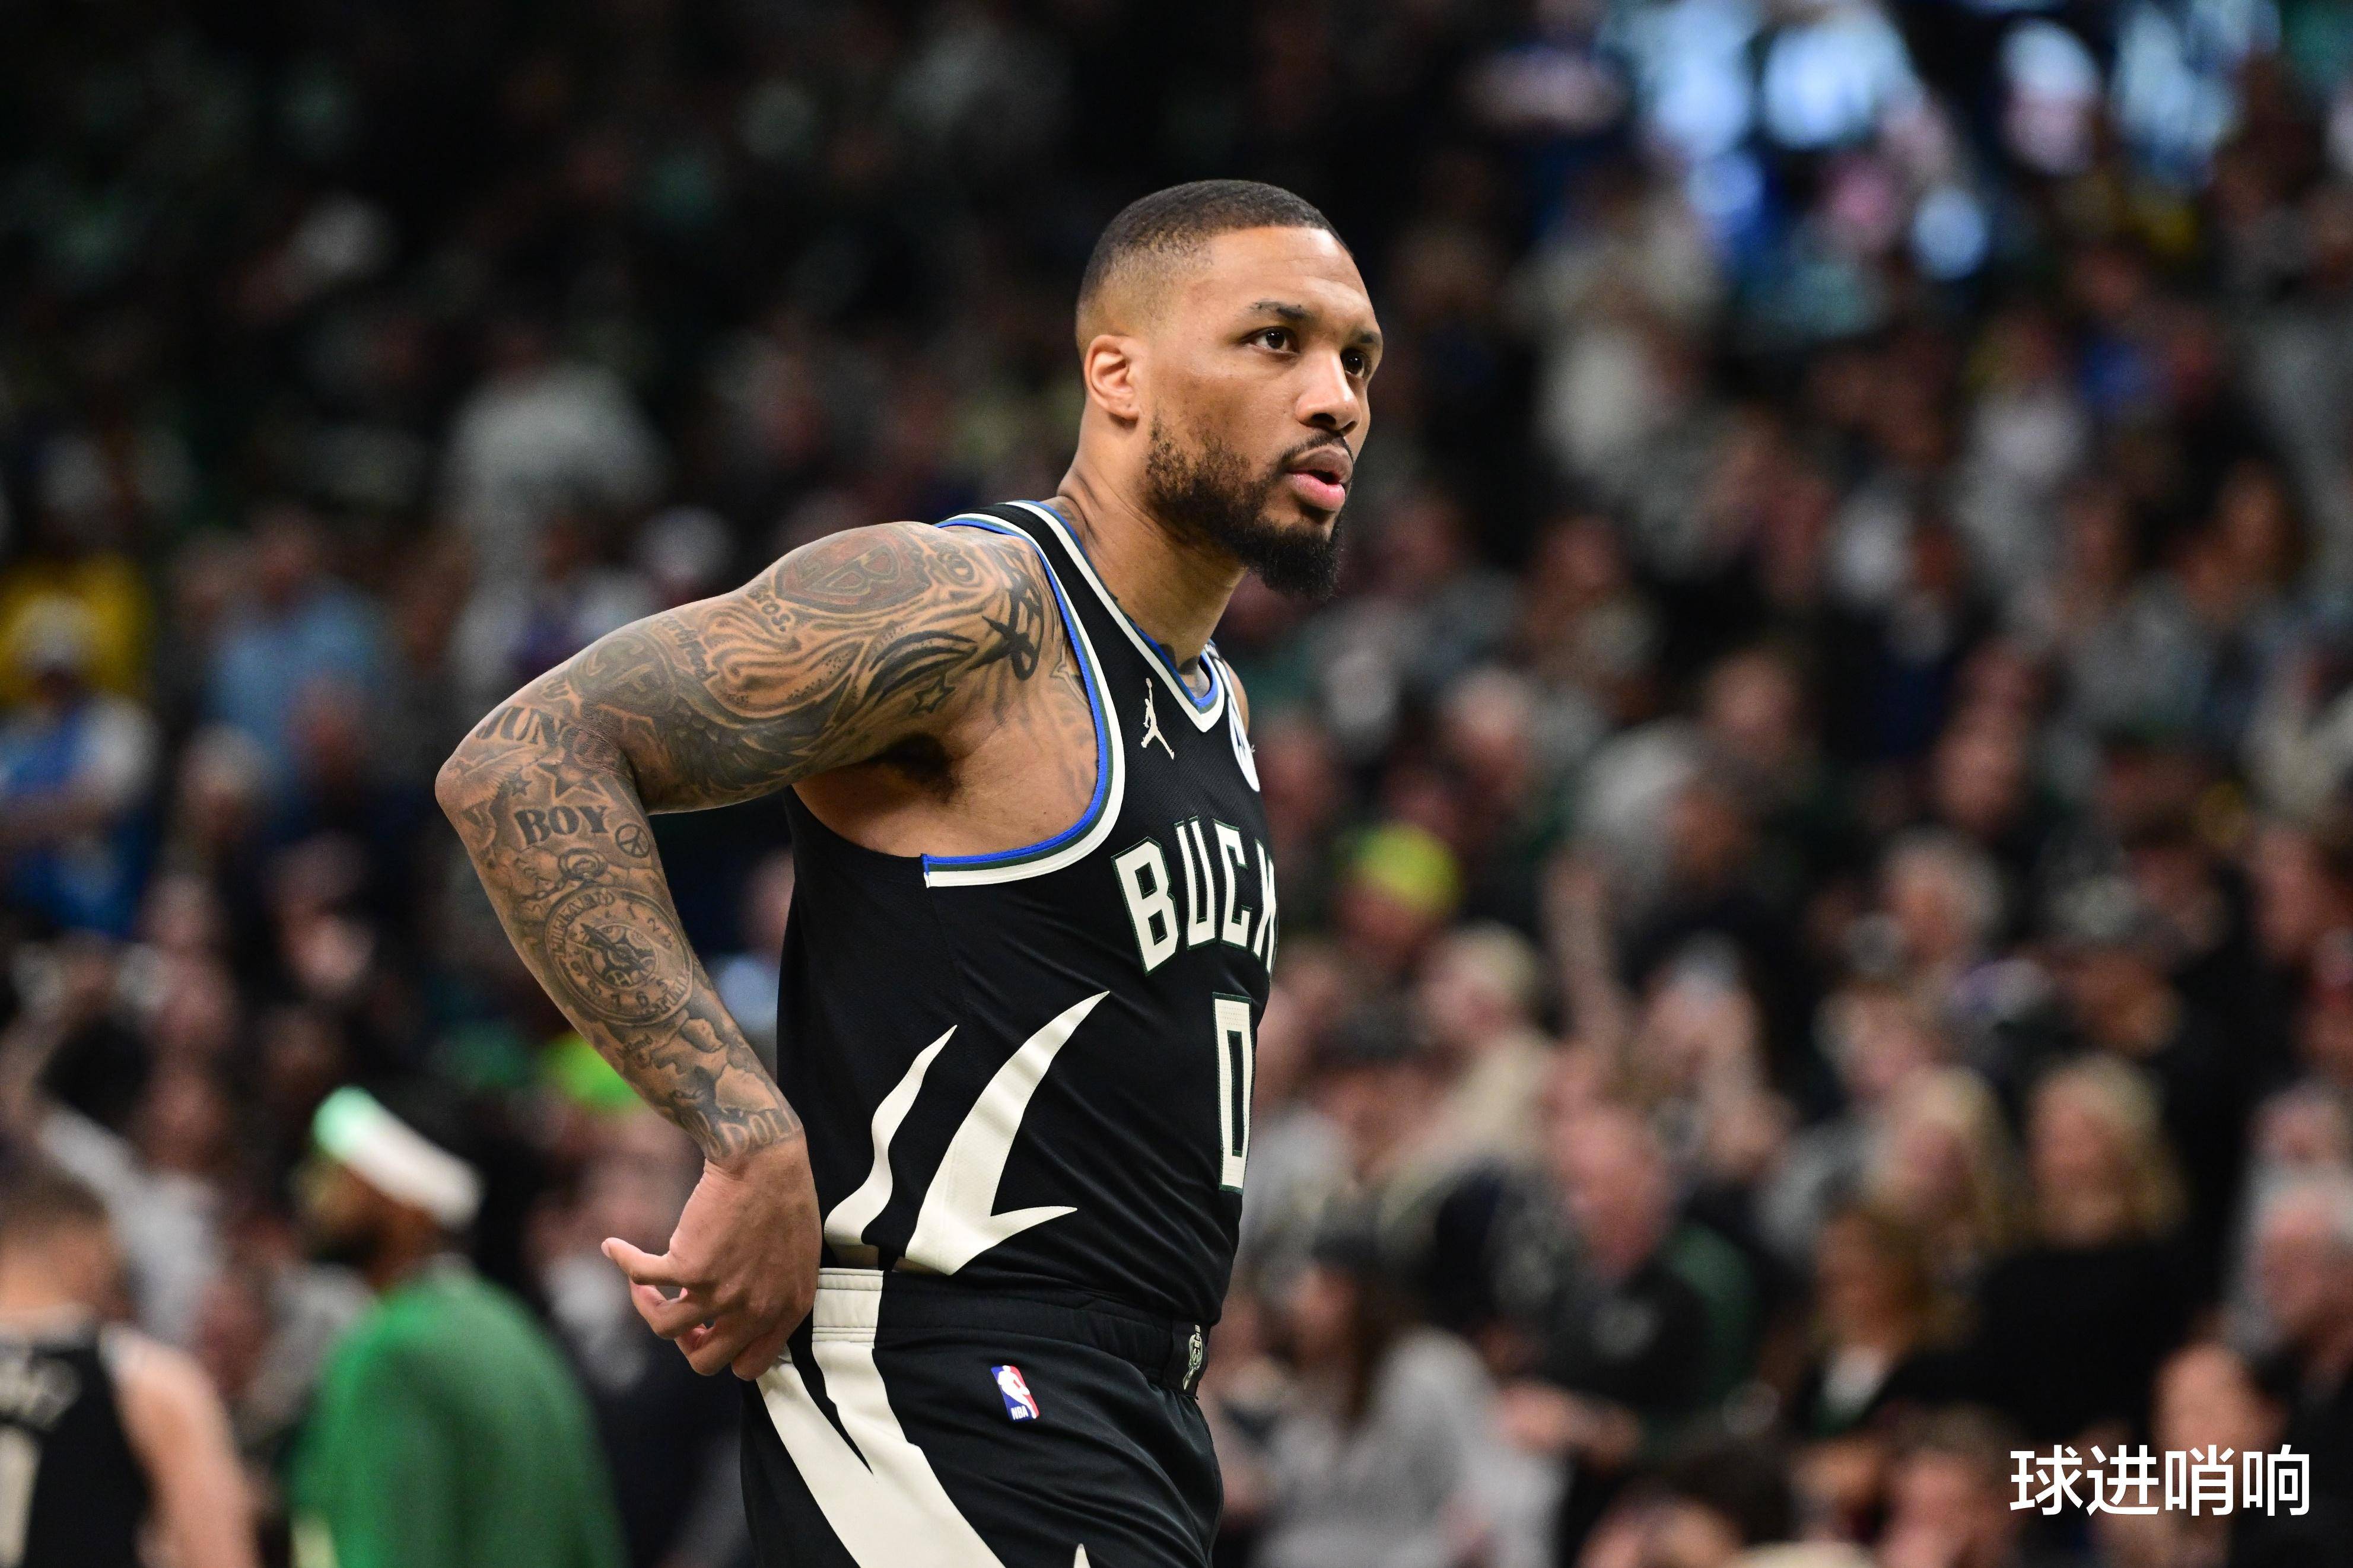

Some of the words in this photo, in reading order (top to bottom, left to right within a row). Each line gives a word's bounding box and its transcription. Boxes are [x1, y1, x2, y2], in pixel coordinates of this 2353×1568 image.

[514, 805, 609, 845] BOY
[1110, 815, 1277, 976] BUCK
[1212, 992, 1254, 1192] 0
[1011, 1405, 1029, 1420] NBA
